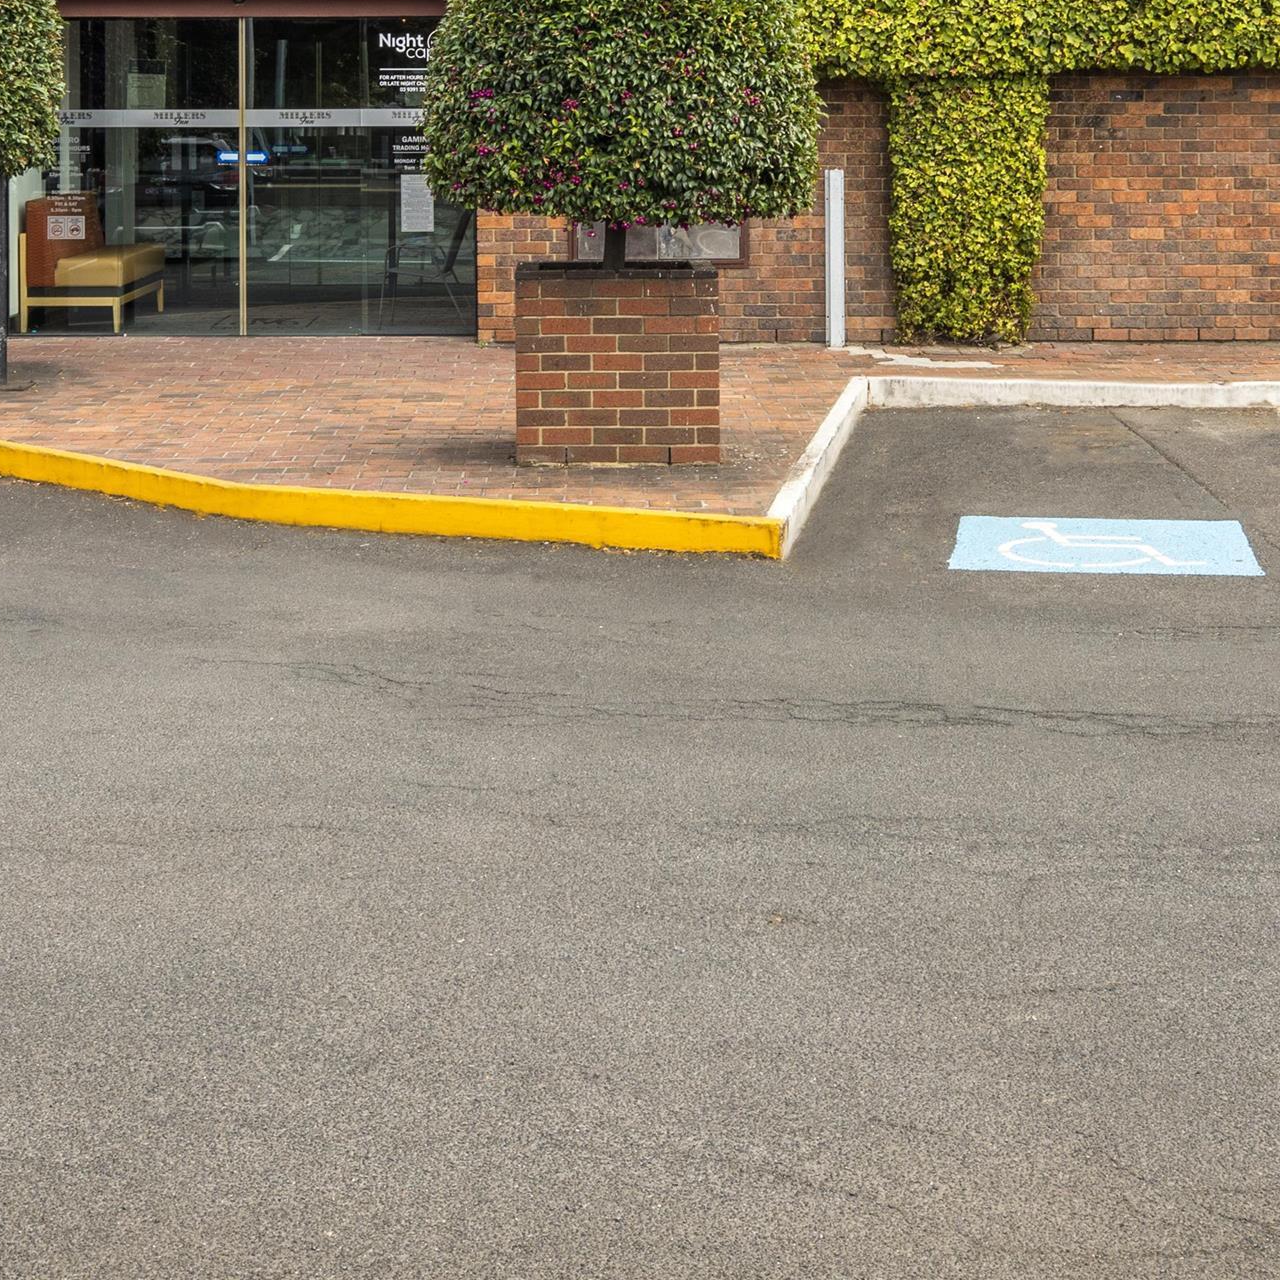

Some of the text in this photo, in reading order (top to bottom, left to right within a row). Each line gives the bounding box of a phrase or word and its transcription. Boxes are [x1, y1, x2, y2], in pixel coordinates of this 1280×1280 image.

[378, 33, 424, 53] Night
[153, 111, 207, 120] MILLERS
[278, 111, 332, 120] MILLERS
[60, 117, 76, 126] Inn
[173, 117, 190, 126] Inn
[299, 116, 315, 126] Inn
[401, 135, 428, 143] GAMIN
